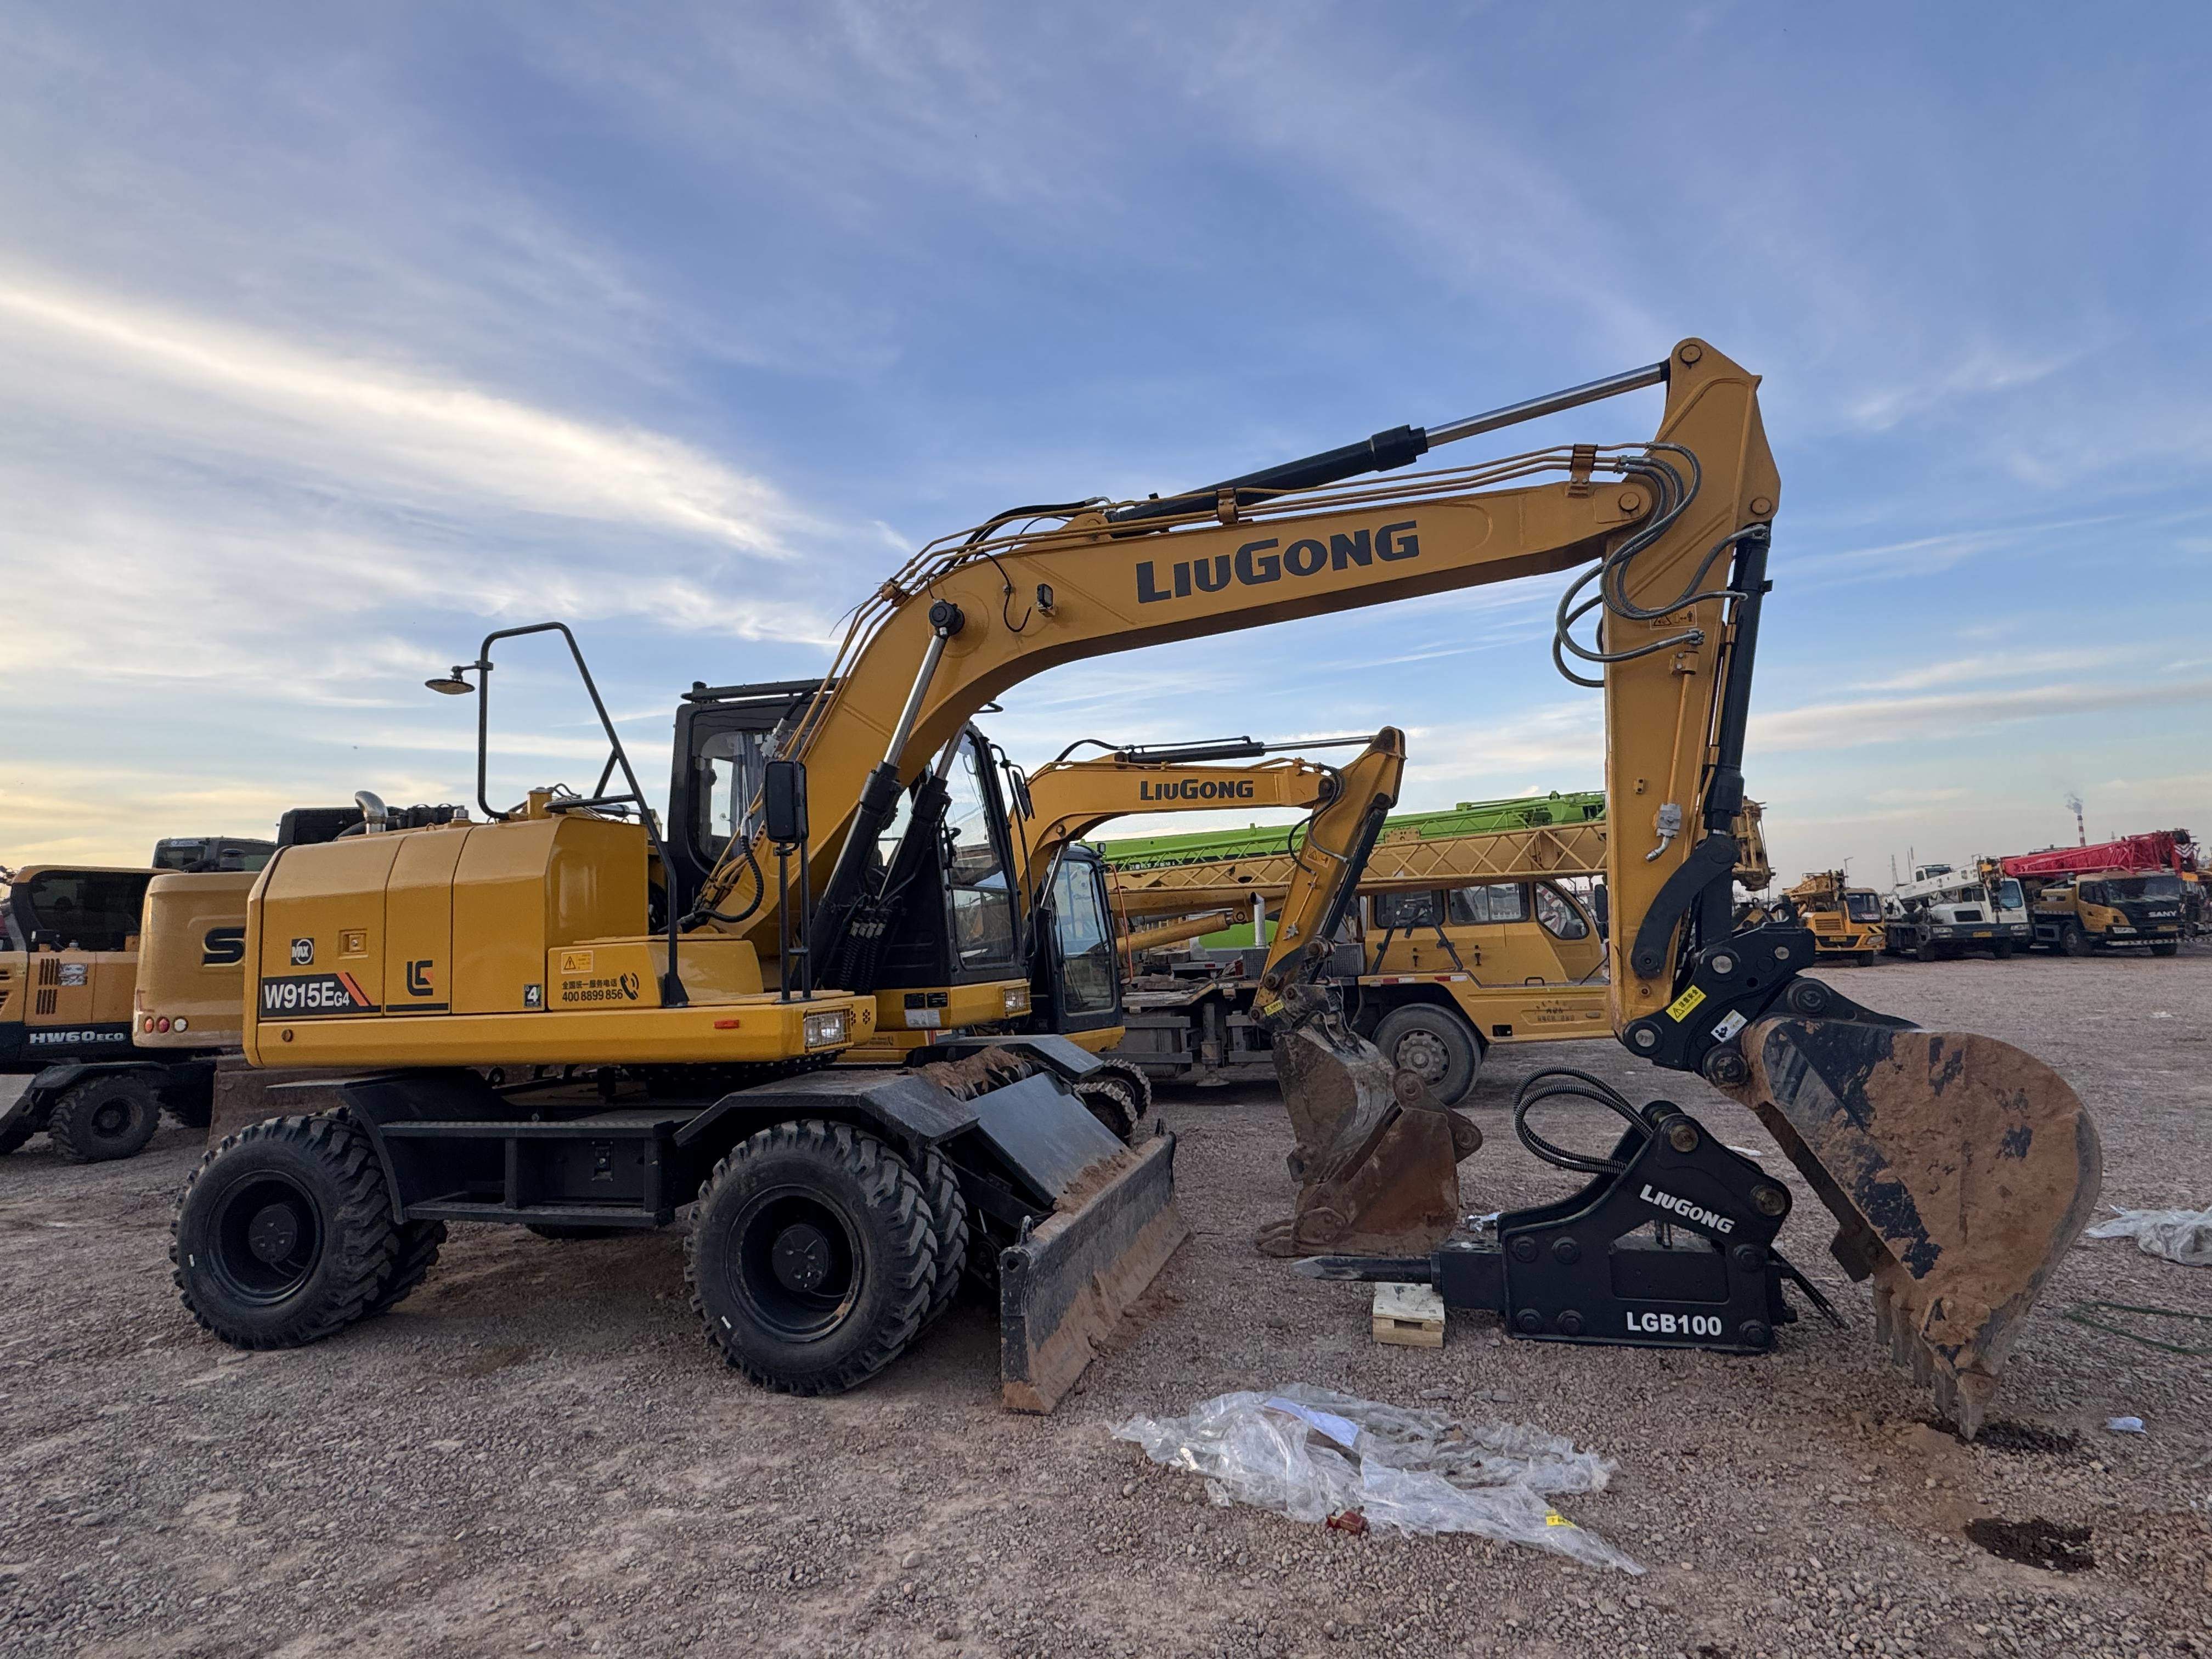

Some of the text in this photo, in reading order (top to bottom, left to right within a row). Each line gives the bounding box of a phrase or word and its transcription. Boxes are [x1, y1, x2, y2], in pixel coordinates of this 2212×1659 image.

[562, 989, 623, 1002] 400 8899 856
[1627, 1311, 1722, 1336] LGB100
